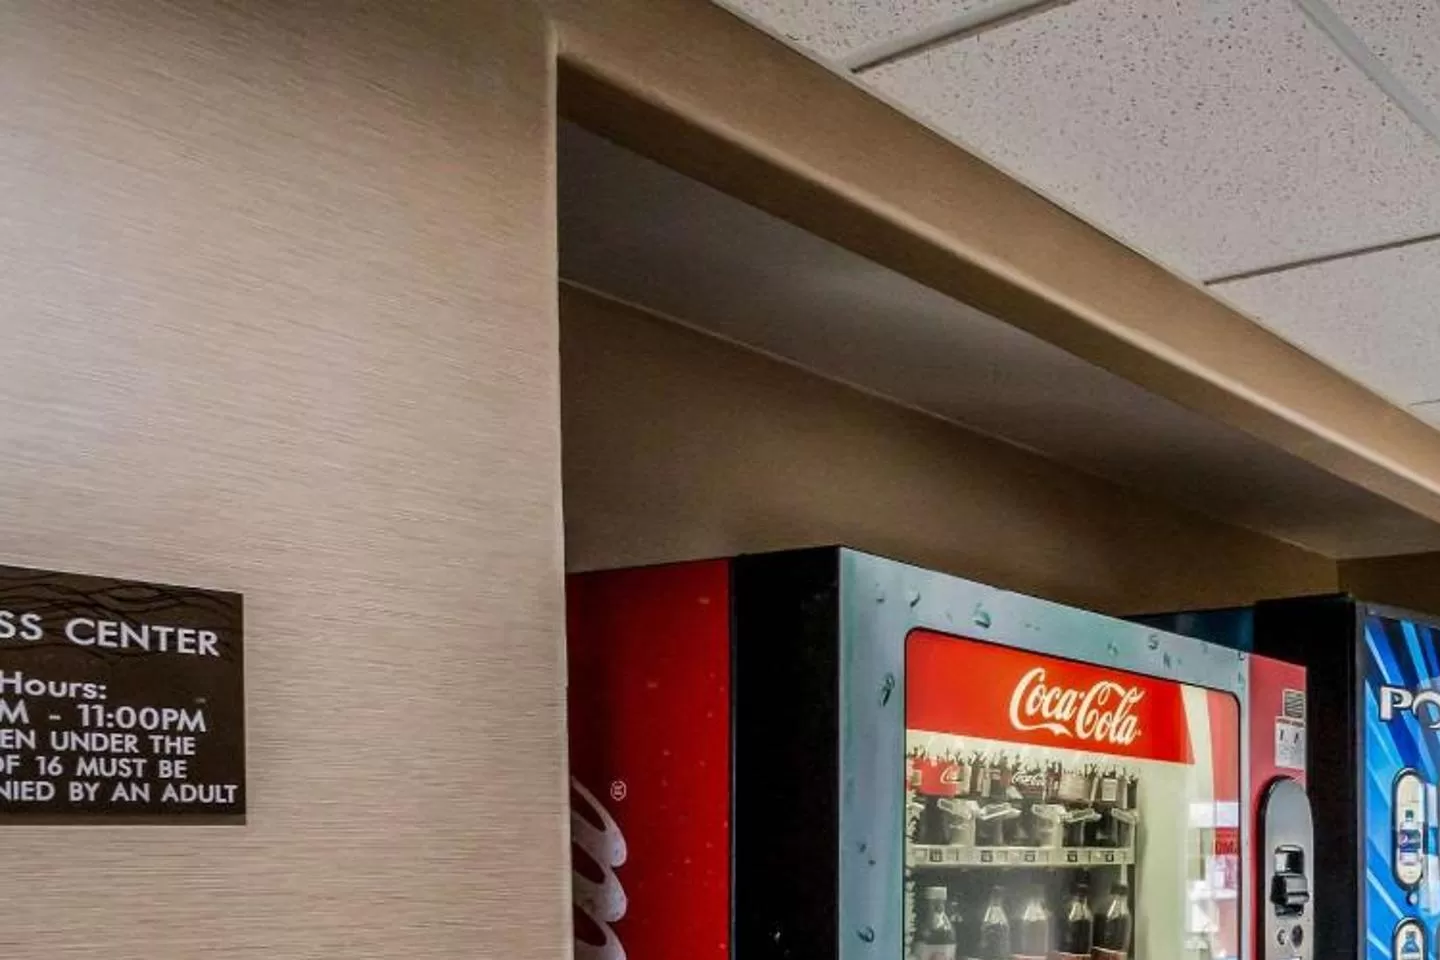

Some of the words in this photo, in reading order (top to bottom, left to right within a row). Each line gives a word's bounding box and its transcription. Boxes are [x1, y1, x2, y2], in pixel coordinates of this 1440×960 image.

[0, 611, 43, 641] SS
[65, 618, 220, 657] CENTER
[0, 671, 107, 700] Hours:
[77, 703, 207, 733] 11:00PM
[1009, 667, 1145, 746] Coca-Cola
[50, 731, 140, 754] UNDER
[149, 735, 196, 756] THE
[0, 754, 20, 775] F
[36, 756, 64, 777] 16
[75, 758, 148, 778] MUST
[158, 760, 188, 779] BE
[68, 783, 100, 802] BY
[111, 783, 151, 803] AN
[161, 784, 239, 804] ADULT
